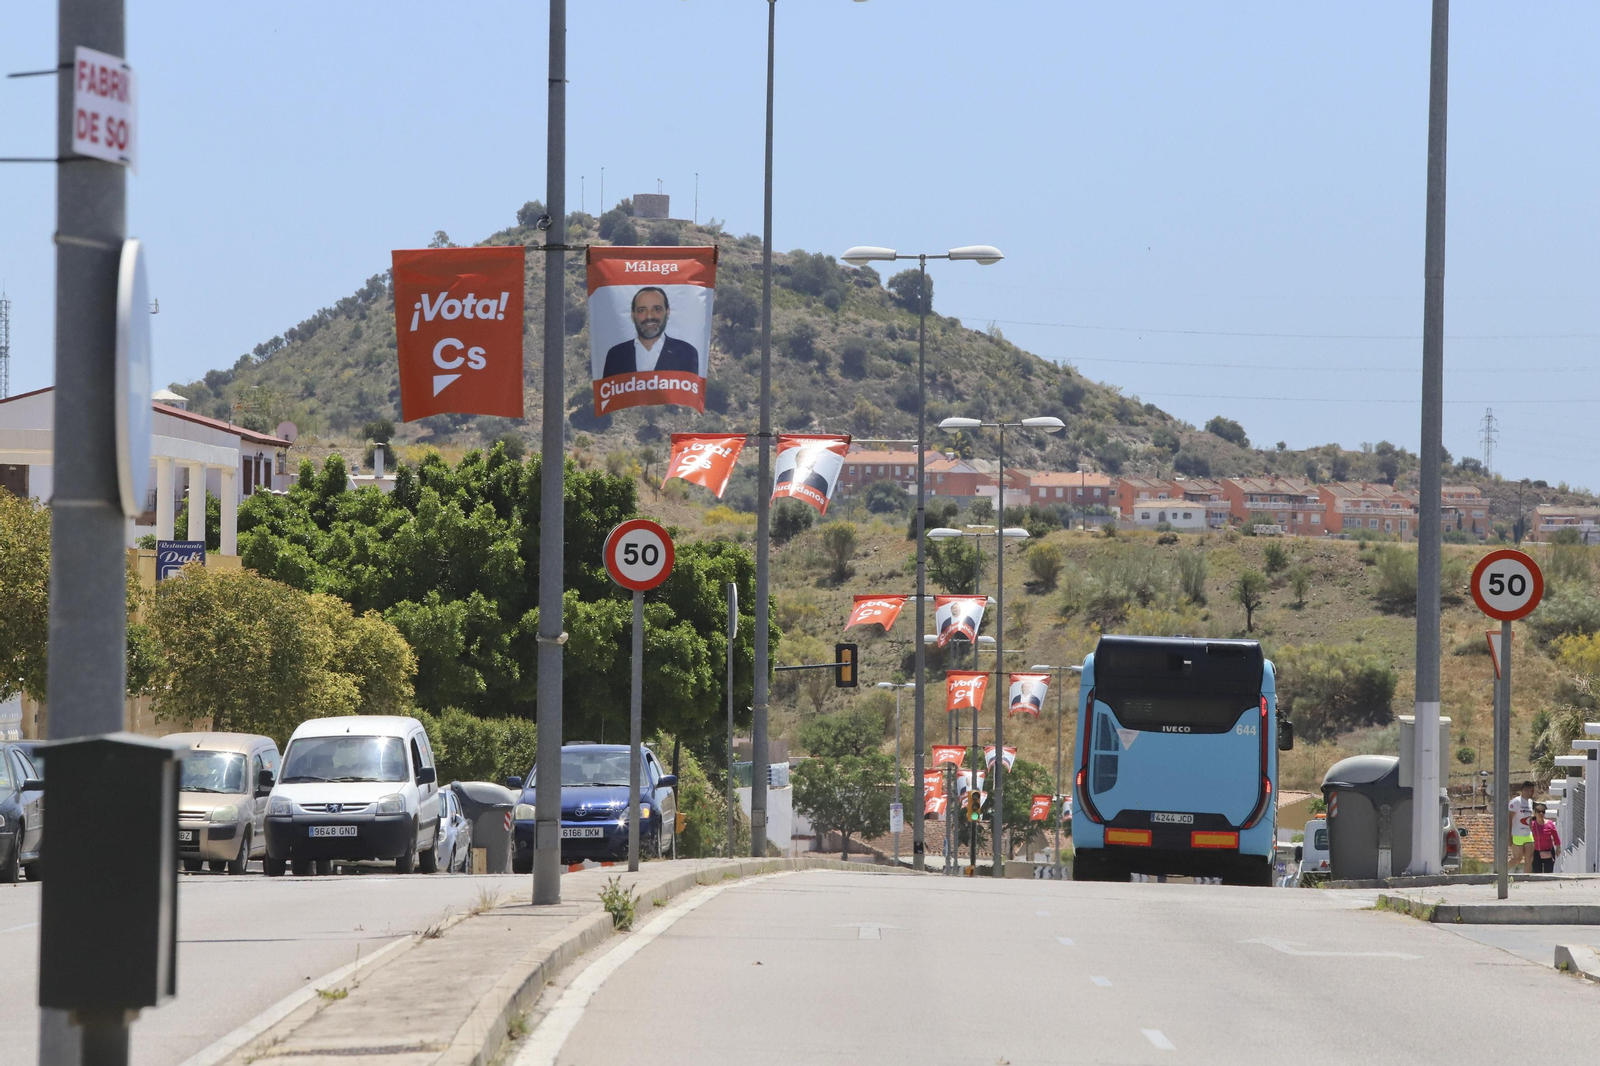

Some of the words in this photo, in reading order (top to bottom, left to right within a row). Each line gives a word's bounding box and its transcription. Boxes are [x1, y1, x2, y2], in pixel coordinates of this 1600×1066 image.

[77, 108, 99, 144] DE
[624, 261, 679, 275] Málaga
[410, 291, 510, 332] ¡Vota!
[432, 337, 487, 370] Cs
[600, 375, 699, 399] Ciudadanos
[159, 541, 203, 549] Restaurante
[623, 543, 659, 566] 50
[1488, 573, 1527, 596] 50
[855, 600, 897, 613] ¡Vota!
[859, 608, 882, 616] Cs
[1162, 725, 1191, 733] IVECO
[1236, 725, 1257, 736] 644
[1155, 813, 1175, 822] 4244
[1178, 815, 1192, 823] JCD
[314, 827, 336, 836] 9648
[339, 827, 356, 836] GND
[562, 829, 582, 837] 6166
[585, 829, 600, 837] DKM
